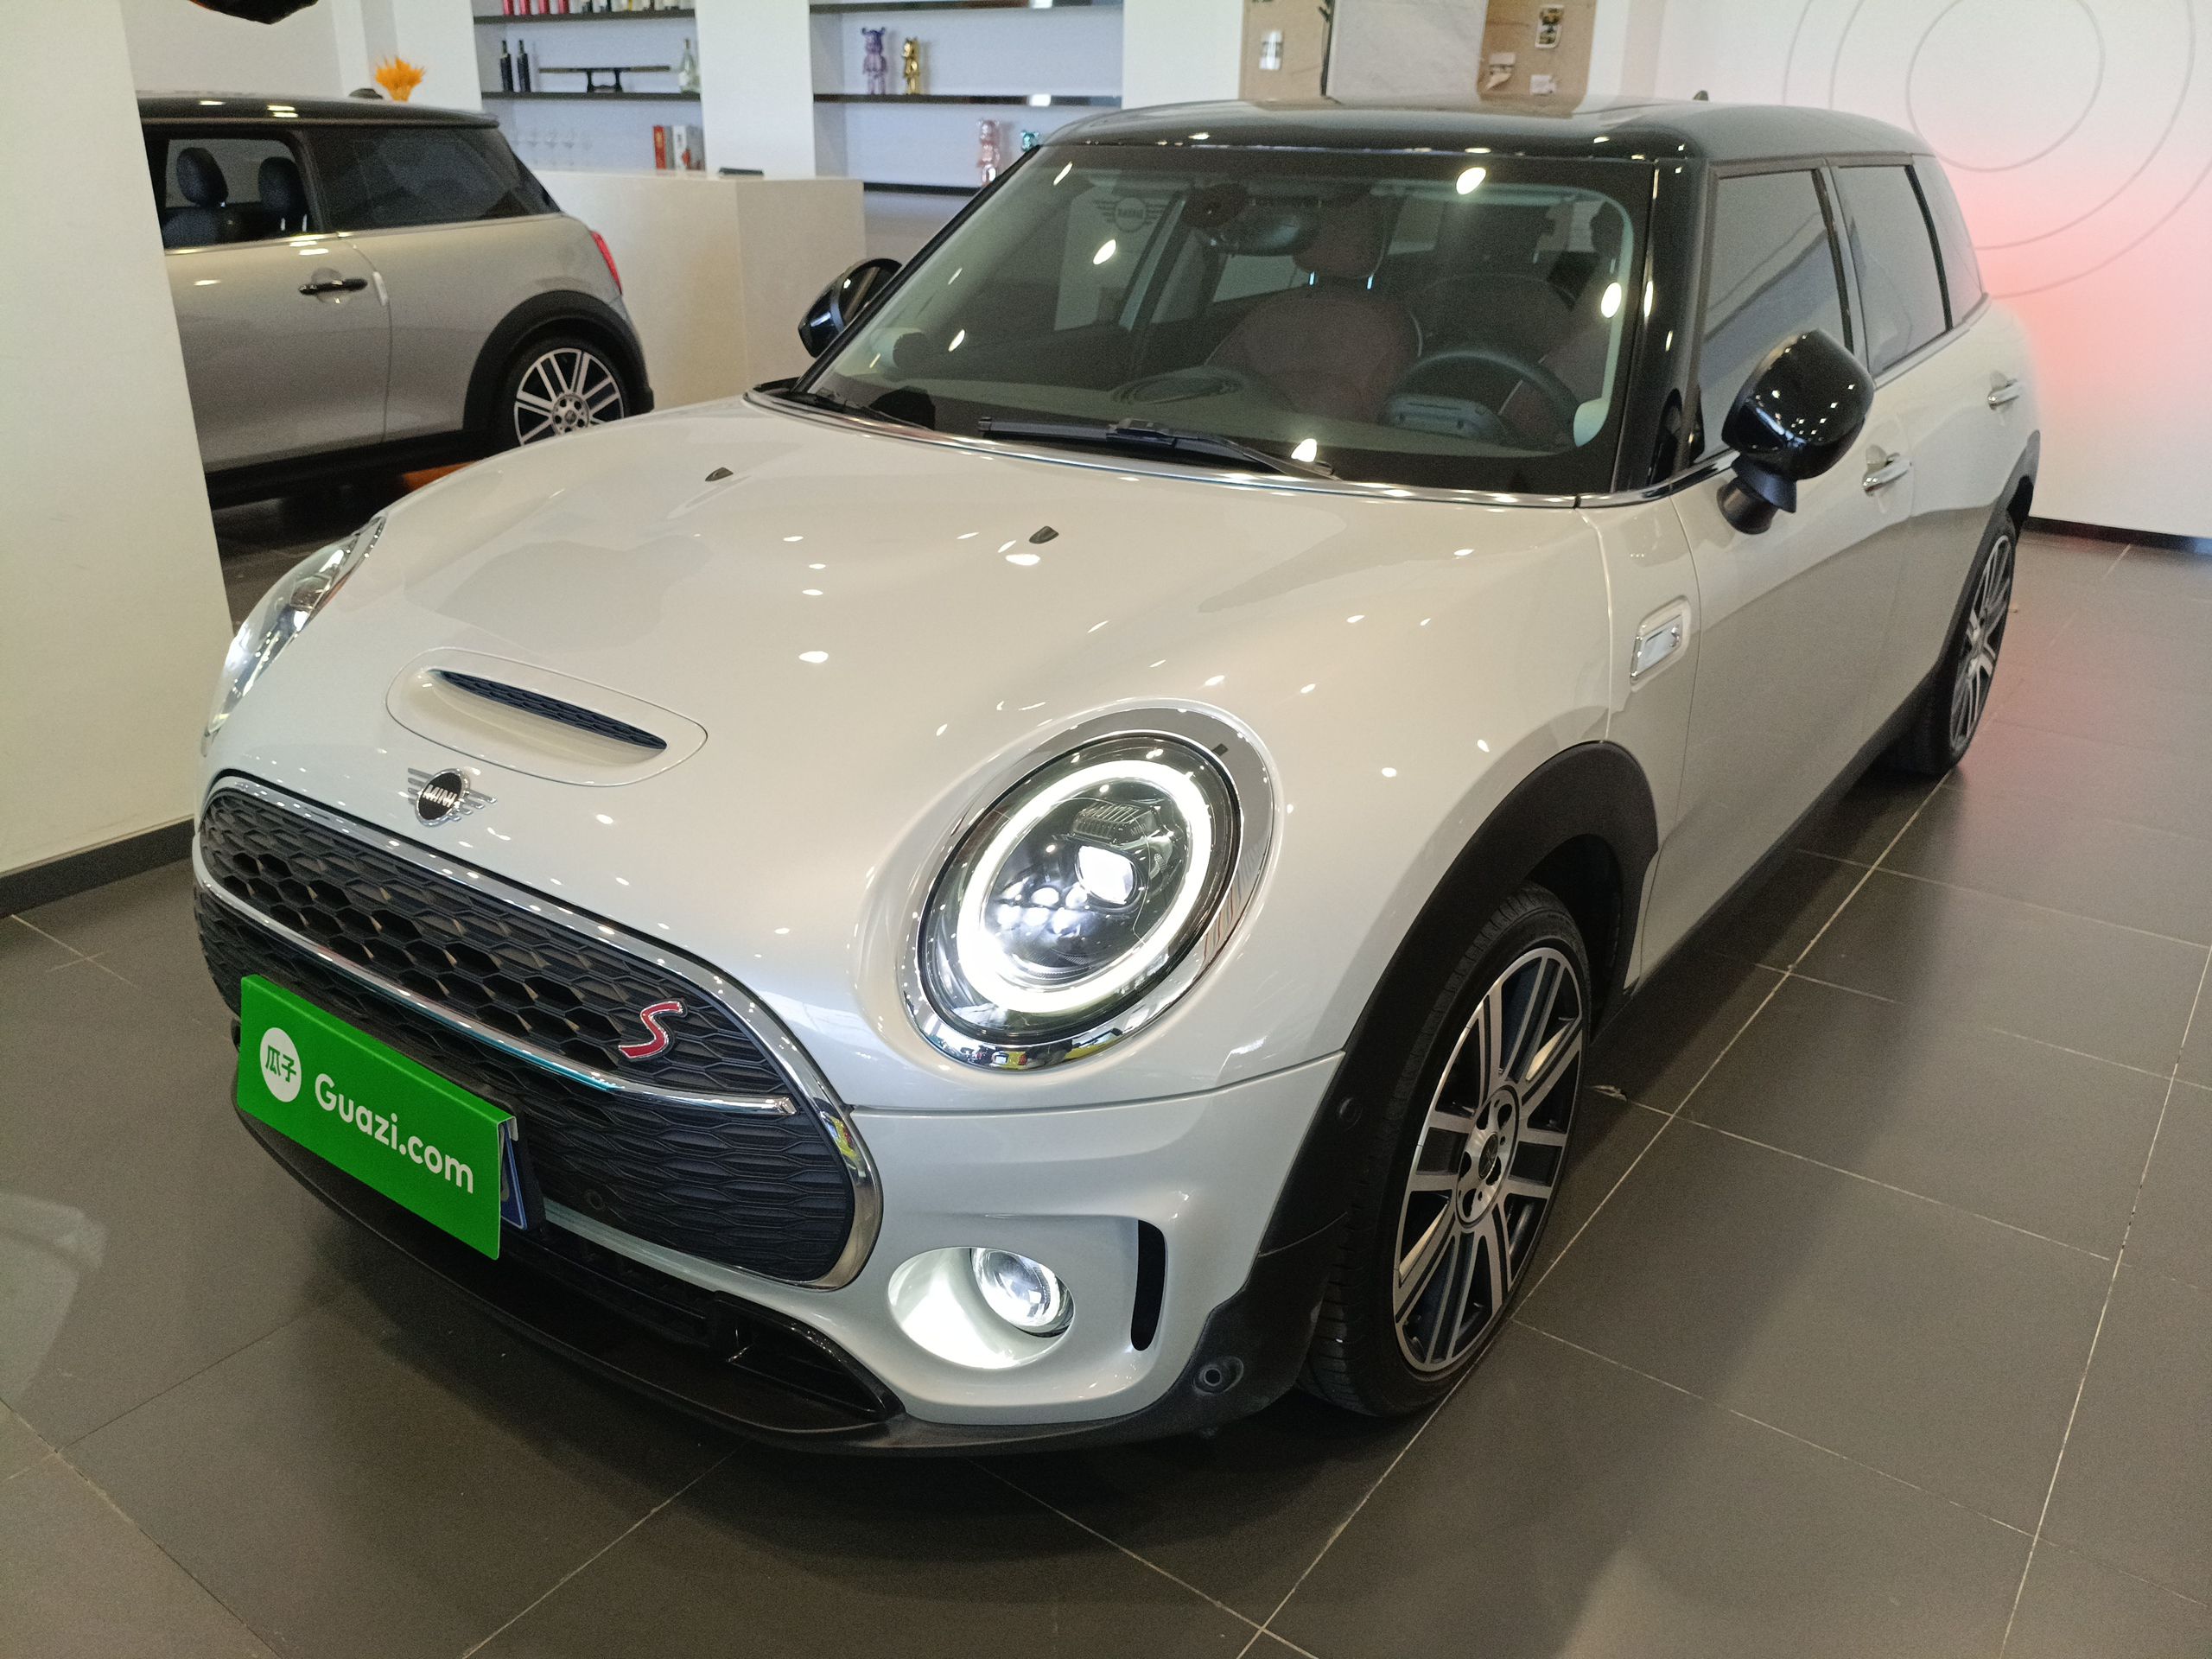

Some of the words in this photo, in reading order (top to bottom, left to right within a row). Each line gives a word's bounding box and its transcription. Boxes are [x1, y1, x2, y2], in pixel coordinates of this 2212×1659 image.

[619, 1000, 684, 1059] S
[264, 1045, 297, 1084] 瓜子
[315, 1073, 474, 1194] Guazi.com
